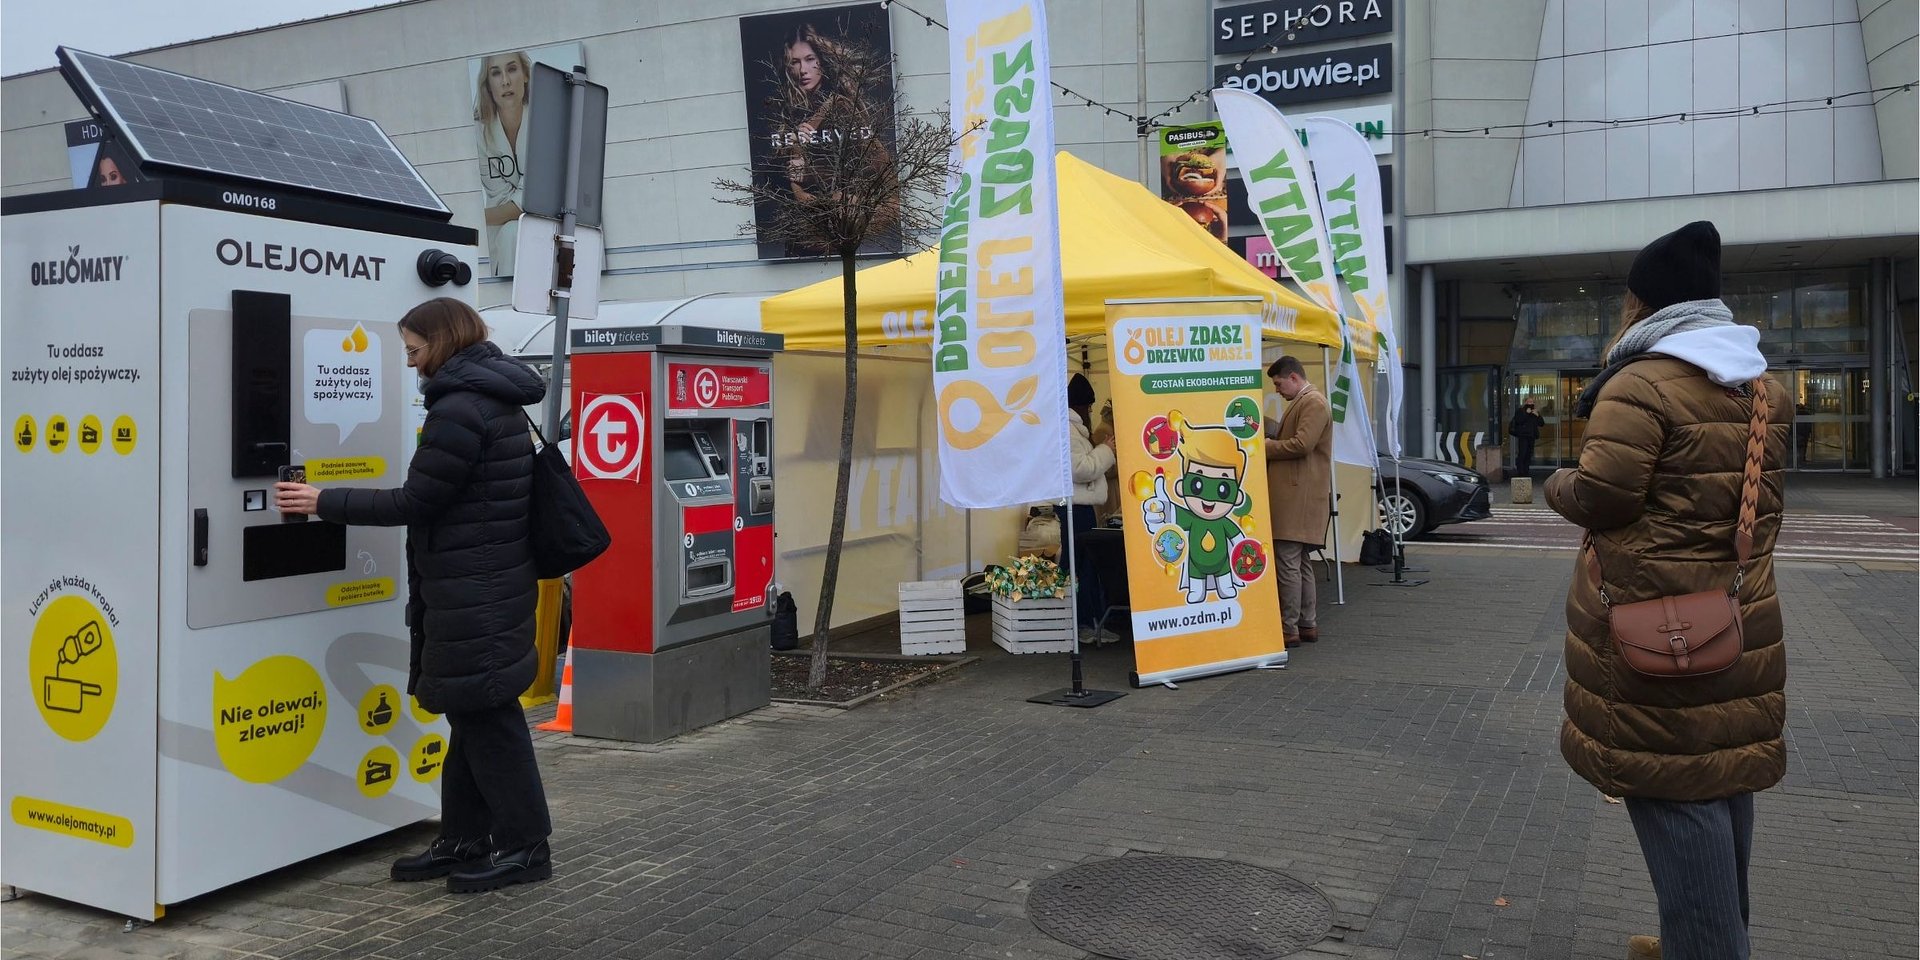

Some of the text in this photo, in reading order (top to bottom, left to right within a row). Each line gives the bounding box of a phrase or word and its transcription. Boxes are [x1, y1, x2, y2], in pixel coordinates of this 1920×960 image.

[1221, 0, 1382, 40] SEPHORA
[1168, 131, 1205, 142] PASIBUS
[222, 191, 276, 211] OM0168
[31, 251, 123, 287] OLEJOMATY
[216, 238, 386, 282] OLEJOMAT
[882, 309, 934, 339] OLE
[584, 331, 649, 345] bilety tickets
[717, 331, 766, 346] bilety tickets
[1145, 327, 1184, 347] OLEJ
[47, 343, 104, 358] Tu oddasz
[1146, 348, 1205, 363] DRZEWKO
[12, 365, 141, 384] zużyty olej spożywczy.
[317, 364, 370, 375] Tu oddasz
[315, 377, 372, 389] zużyty olej
[1151, 375, 1255, 389] ZOSTAŃ EKOBOHATEREM!
[313, 389, 374, 401] spożywczy.
[29, 575, 120, 628] Liczy się każda kropla!
[1148, 607, 1232, 632] www.ozdm.pl
[221, 691, 322, 725] Nie olewaj,
[239, 713, 304, 742] zlewaj!
[28, 809, 116, 839] www.olejomaty.pl
